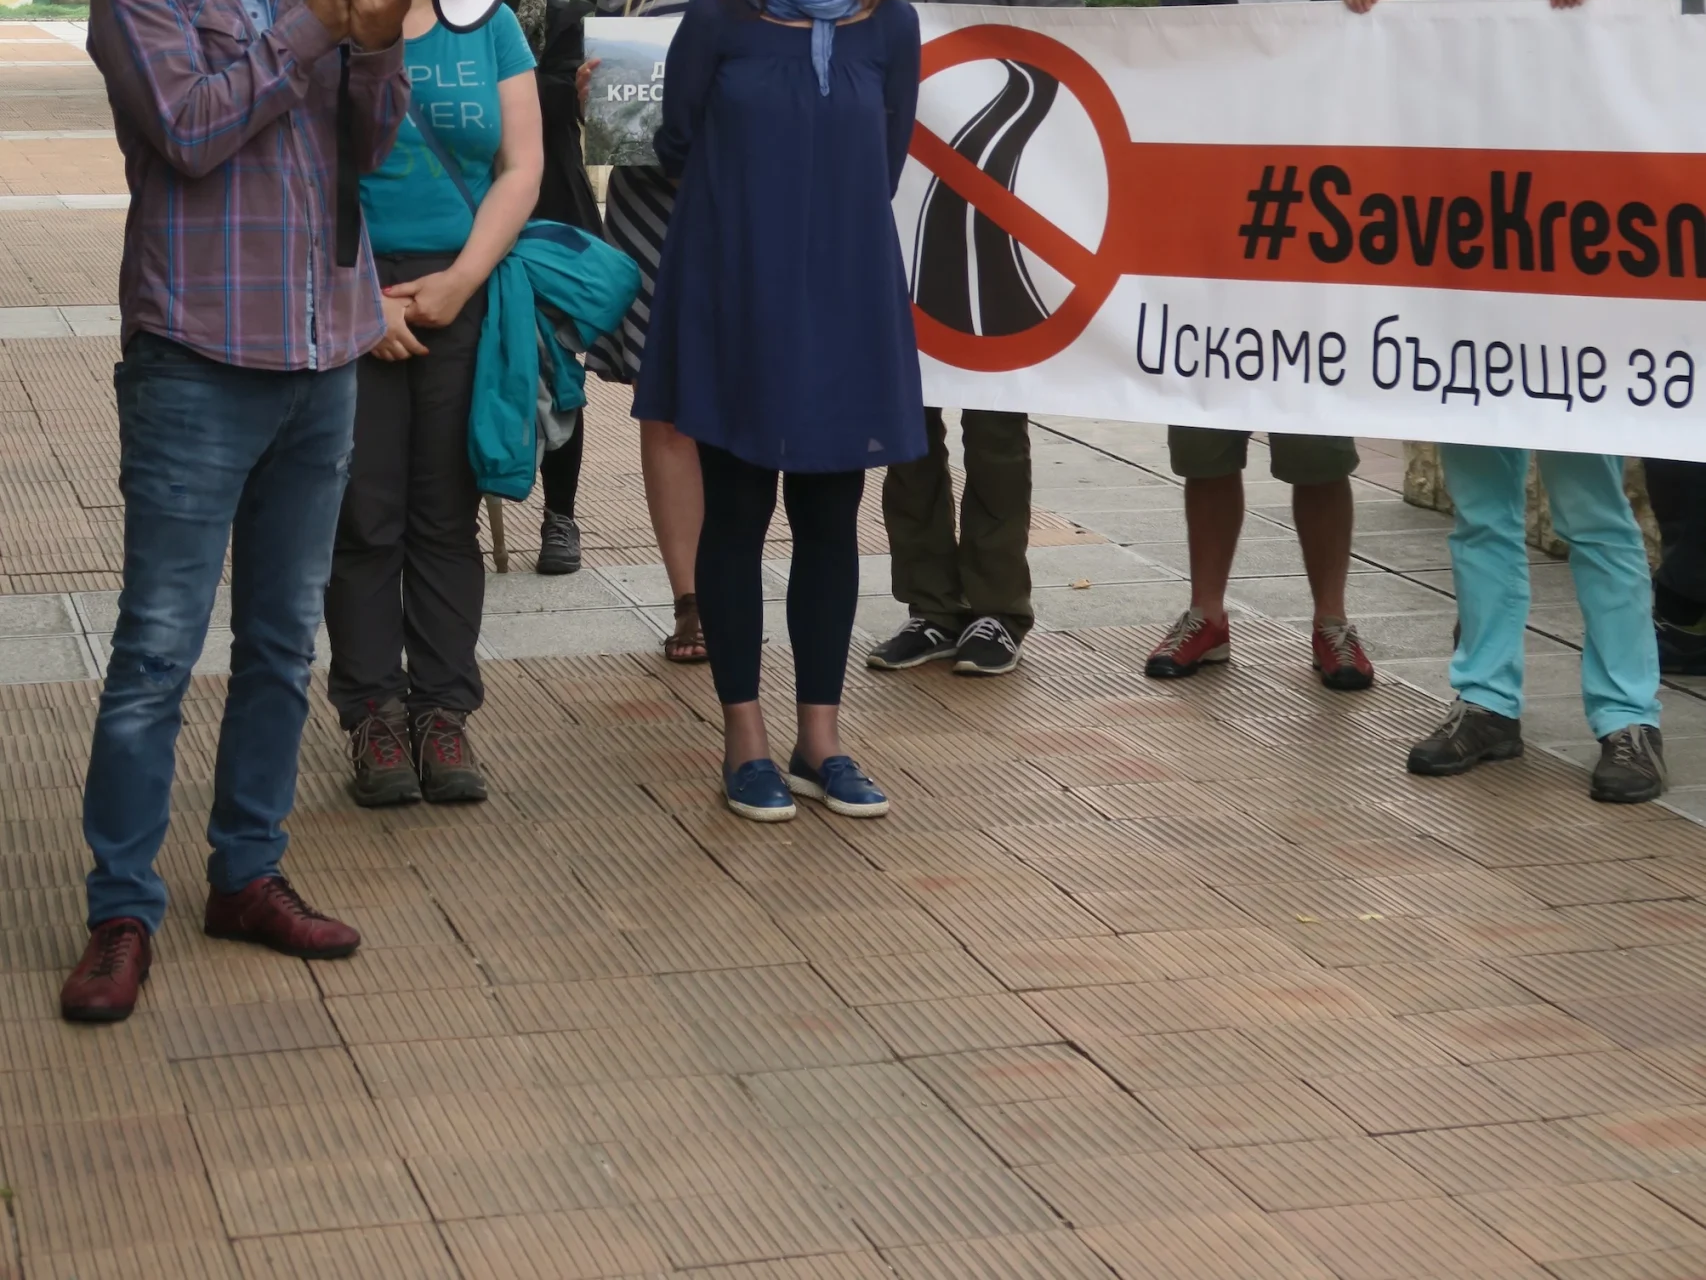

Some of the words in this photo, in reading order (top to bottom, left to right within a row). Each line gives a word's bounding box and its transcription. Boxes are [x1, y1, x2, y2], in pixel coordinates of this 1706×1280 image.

[1238, 164, 1706, 279] #SaveKresn
[1136, 302, 1347, 387] Искаме
[1372, 314, 1607, 413] бъдеще
[1627, 347, 1695, 410] за
